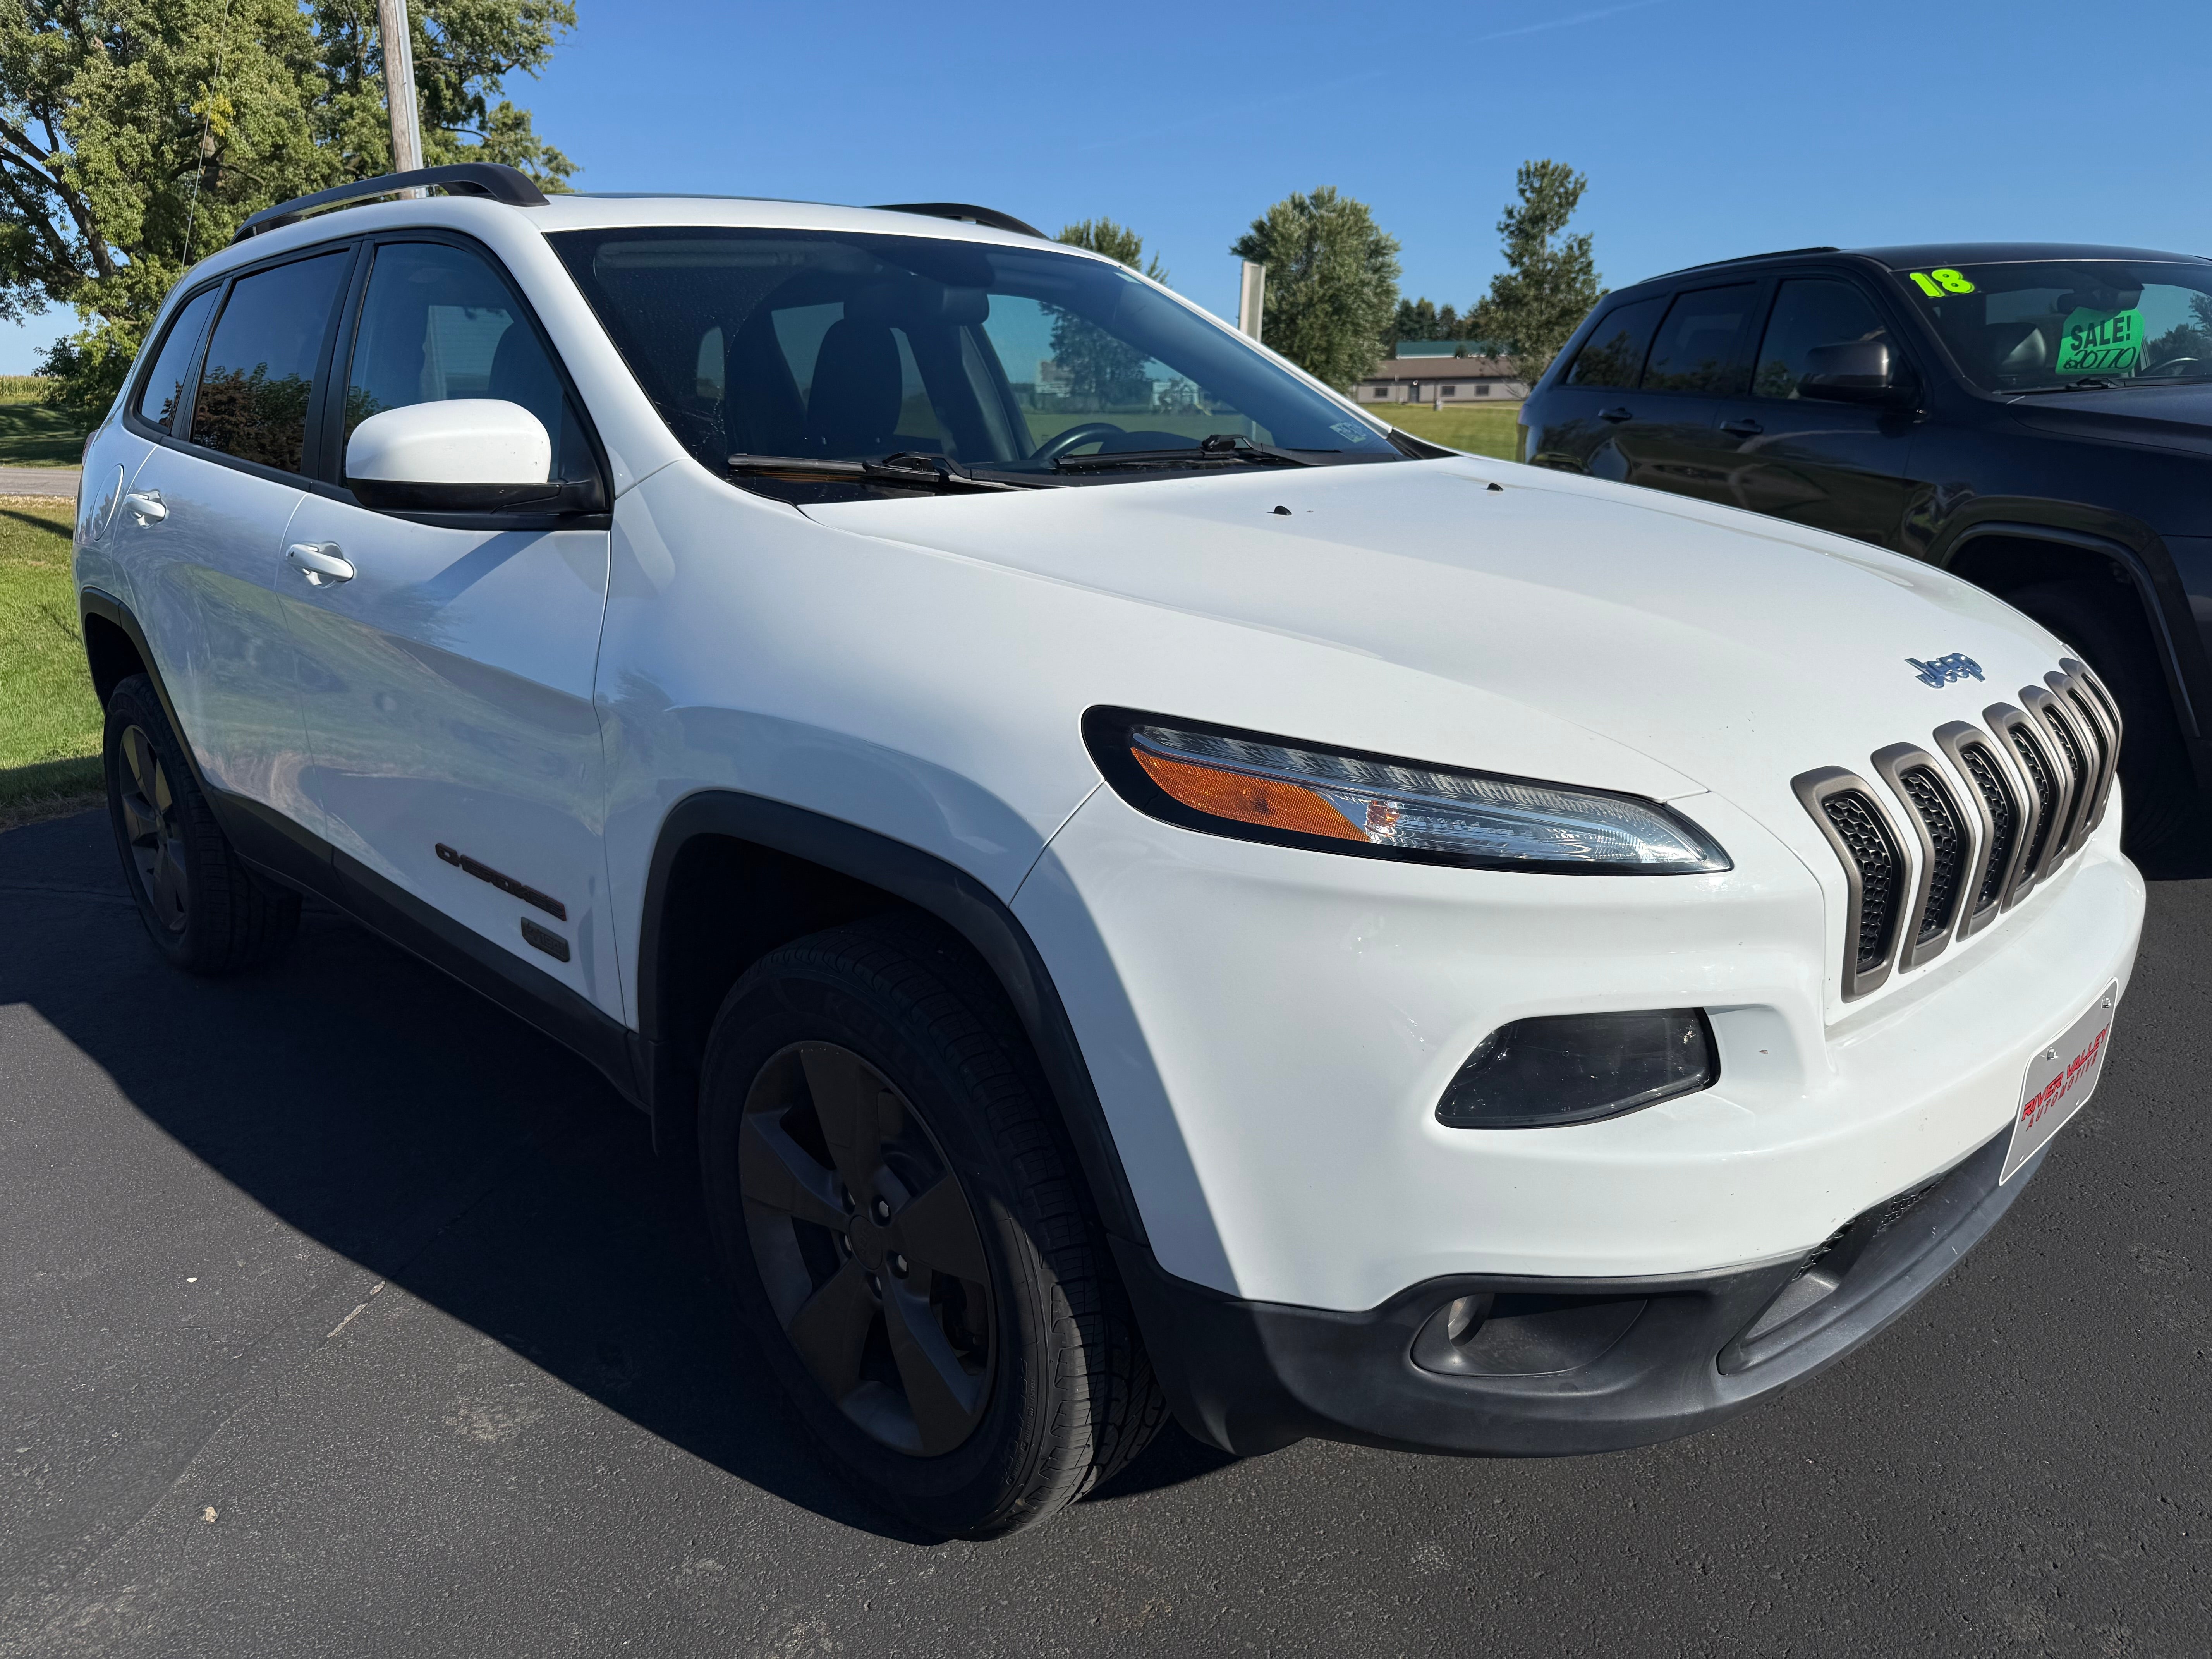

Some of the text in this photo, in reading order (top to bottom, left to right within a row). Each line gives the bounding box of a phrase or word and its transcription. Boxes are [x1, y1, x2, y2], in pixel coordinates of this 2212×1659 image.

[1910, 269, 1975, 297] 18
[2070, 315, 2131, 351] SALE!
[1904, 653, 1985, 688] Jeep
[435, 843, 567, 921] CHEROKEE
[2021, 1022, 2110, 1121] RIVER VALLEY
[2026, 1050, 2098, 1132] AUTOMOTIVE
